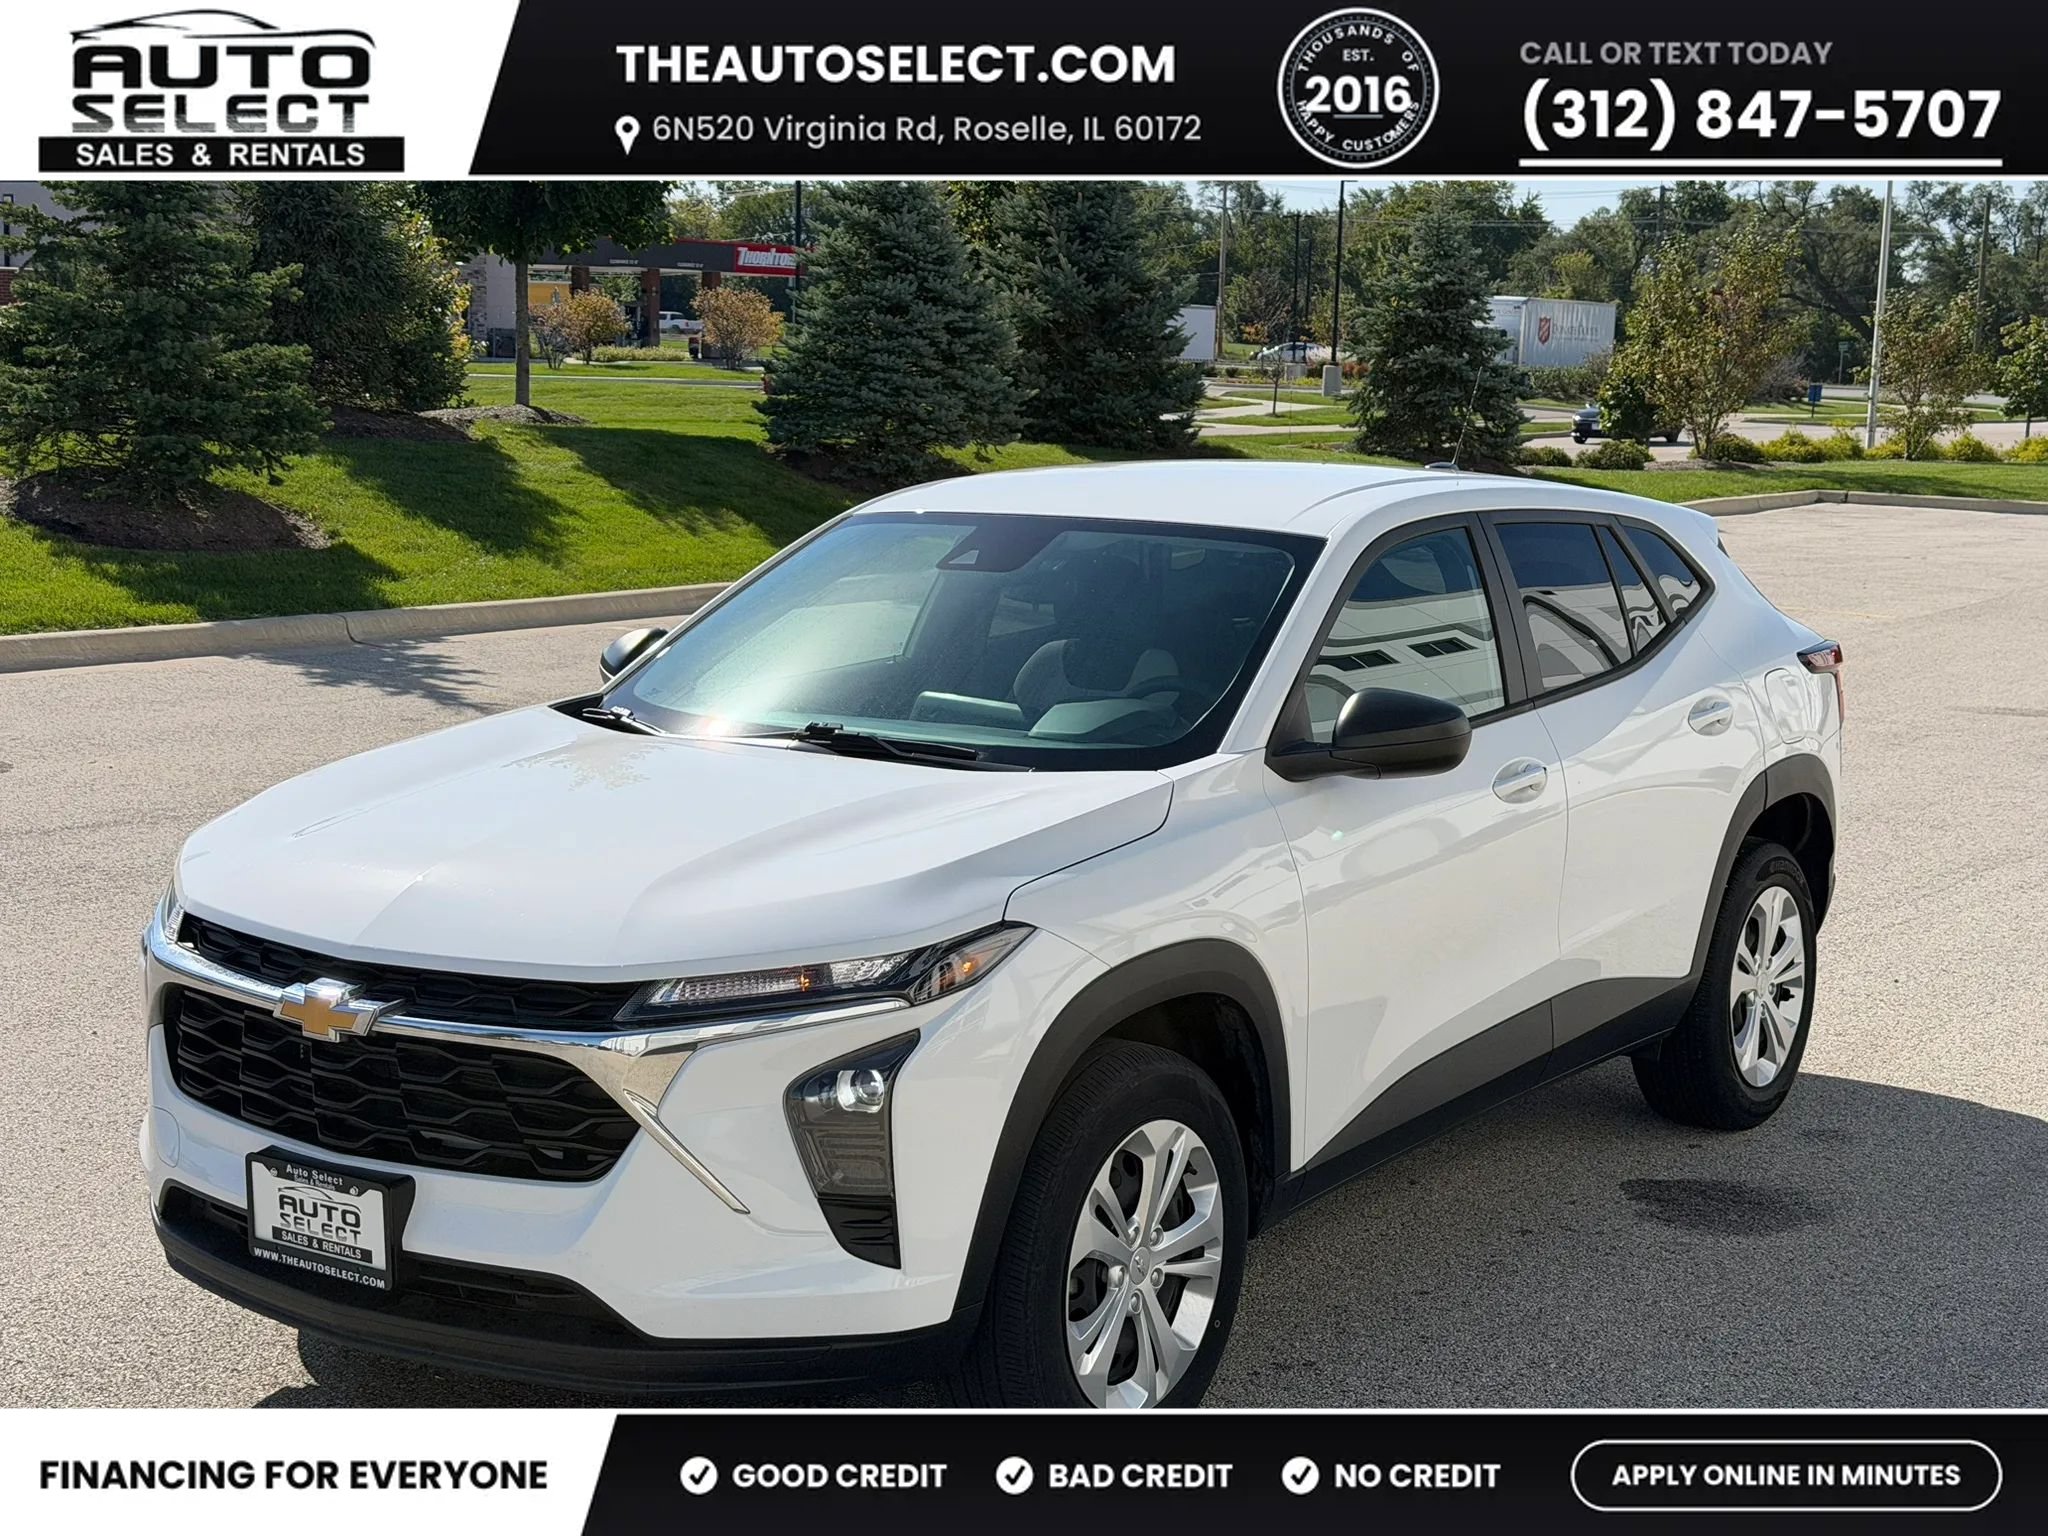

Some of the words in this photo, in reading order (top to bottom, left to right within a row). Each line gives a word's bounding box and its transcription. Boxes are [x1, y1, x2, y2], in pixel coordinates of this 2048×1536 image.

[286, 1163, 309, 1178] Auto
[312, 1169, 344, 1186] Select
[278, 1194, 361, 1229] AUTO
[279, 1212, 361, 1245] SELECT
[281, 1230, 308, 1246] SALES
[312, 1238, 319, 1249] &
[323, 1240, 361, 1259] RENTALS
[254, 1247, 386, 1289] WWW.THEAUTOSELECT.COM
